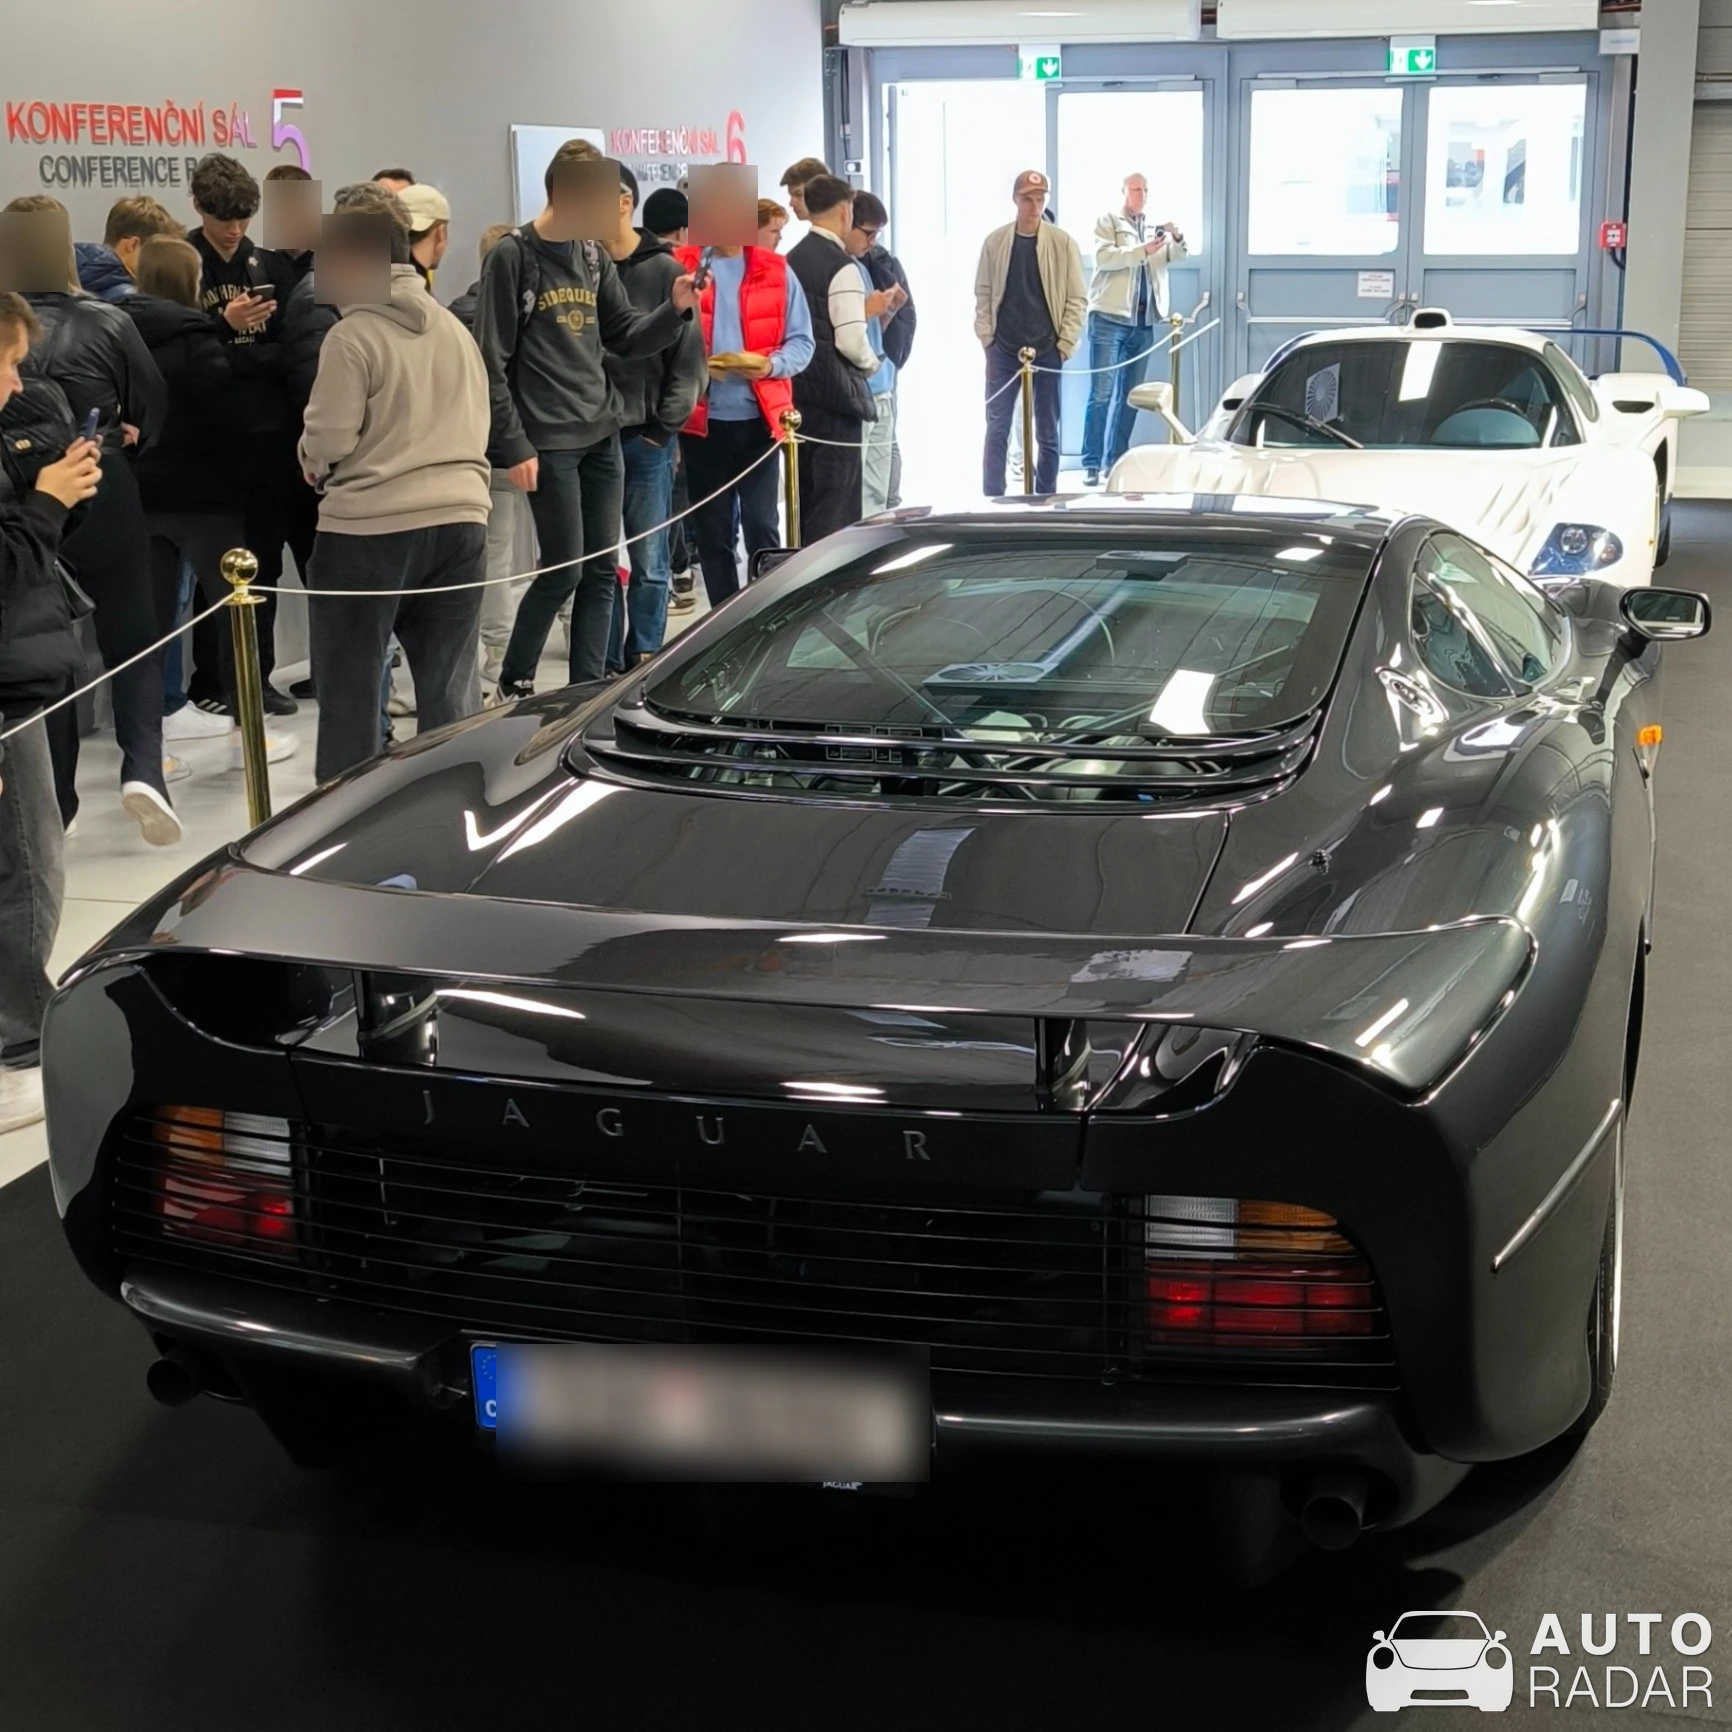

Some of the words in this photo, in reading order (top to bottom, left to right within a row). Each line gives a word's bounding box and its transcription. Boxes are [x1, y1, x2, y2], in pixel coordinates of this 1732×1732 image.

[6, 99, 204, 145] KONFERENČNÍ
[212, 102, 257, 147] SÁL
[271, 88, 310, 177] 5
[727, 109, 747, 165] 6
[40, 155, 181, 187] CONFERENCE
[422, 1089, 932, 1161] JAGUAR
